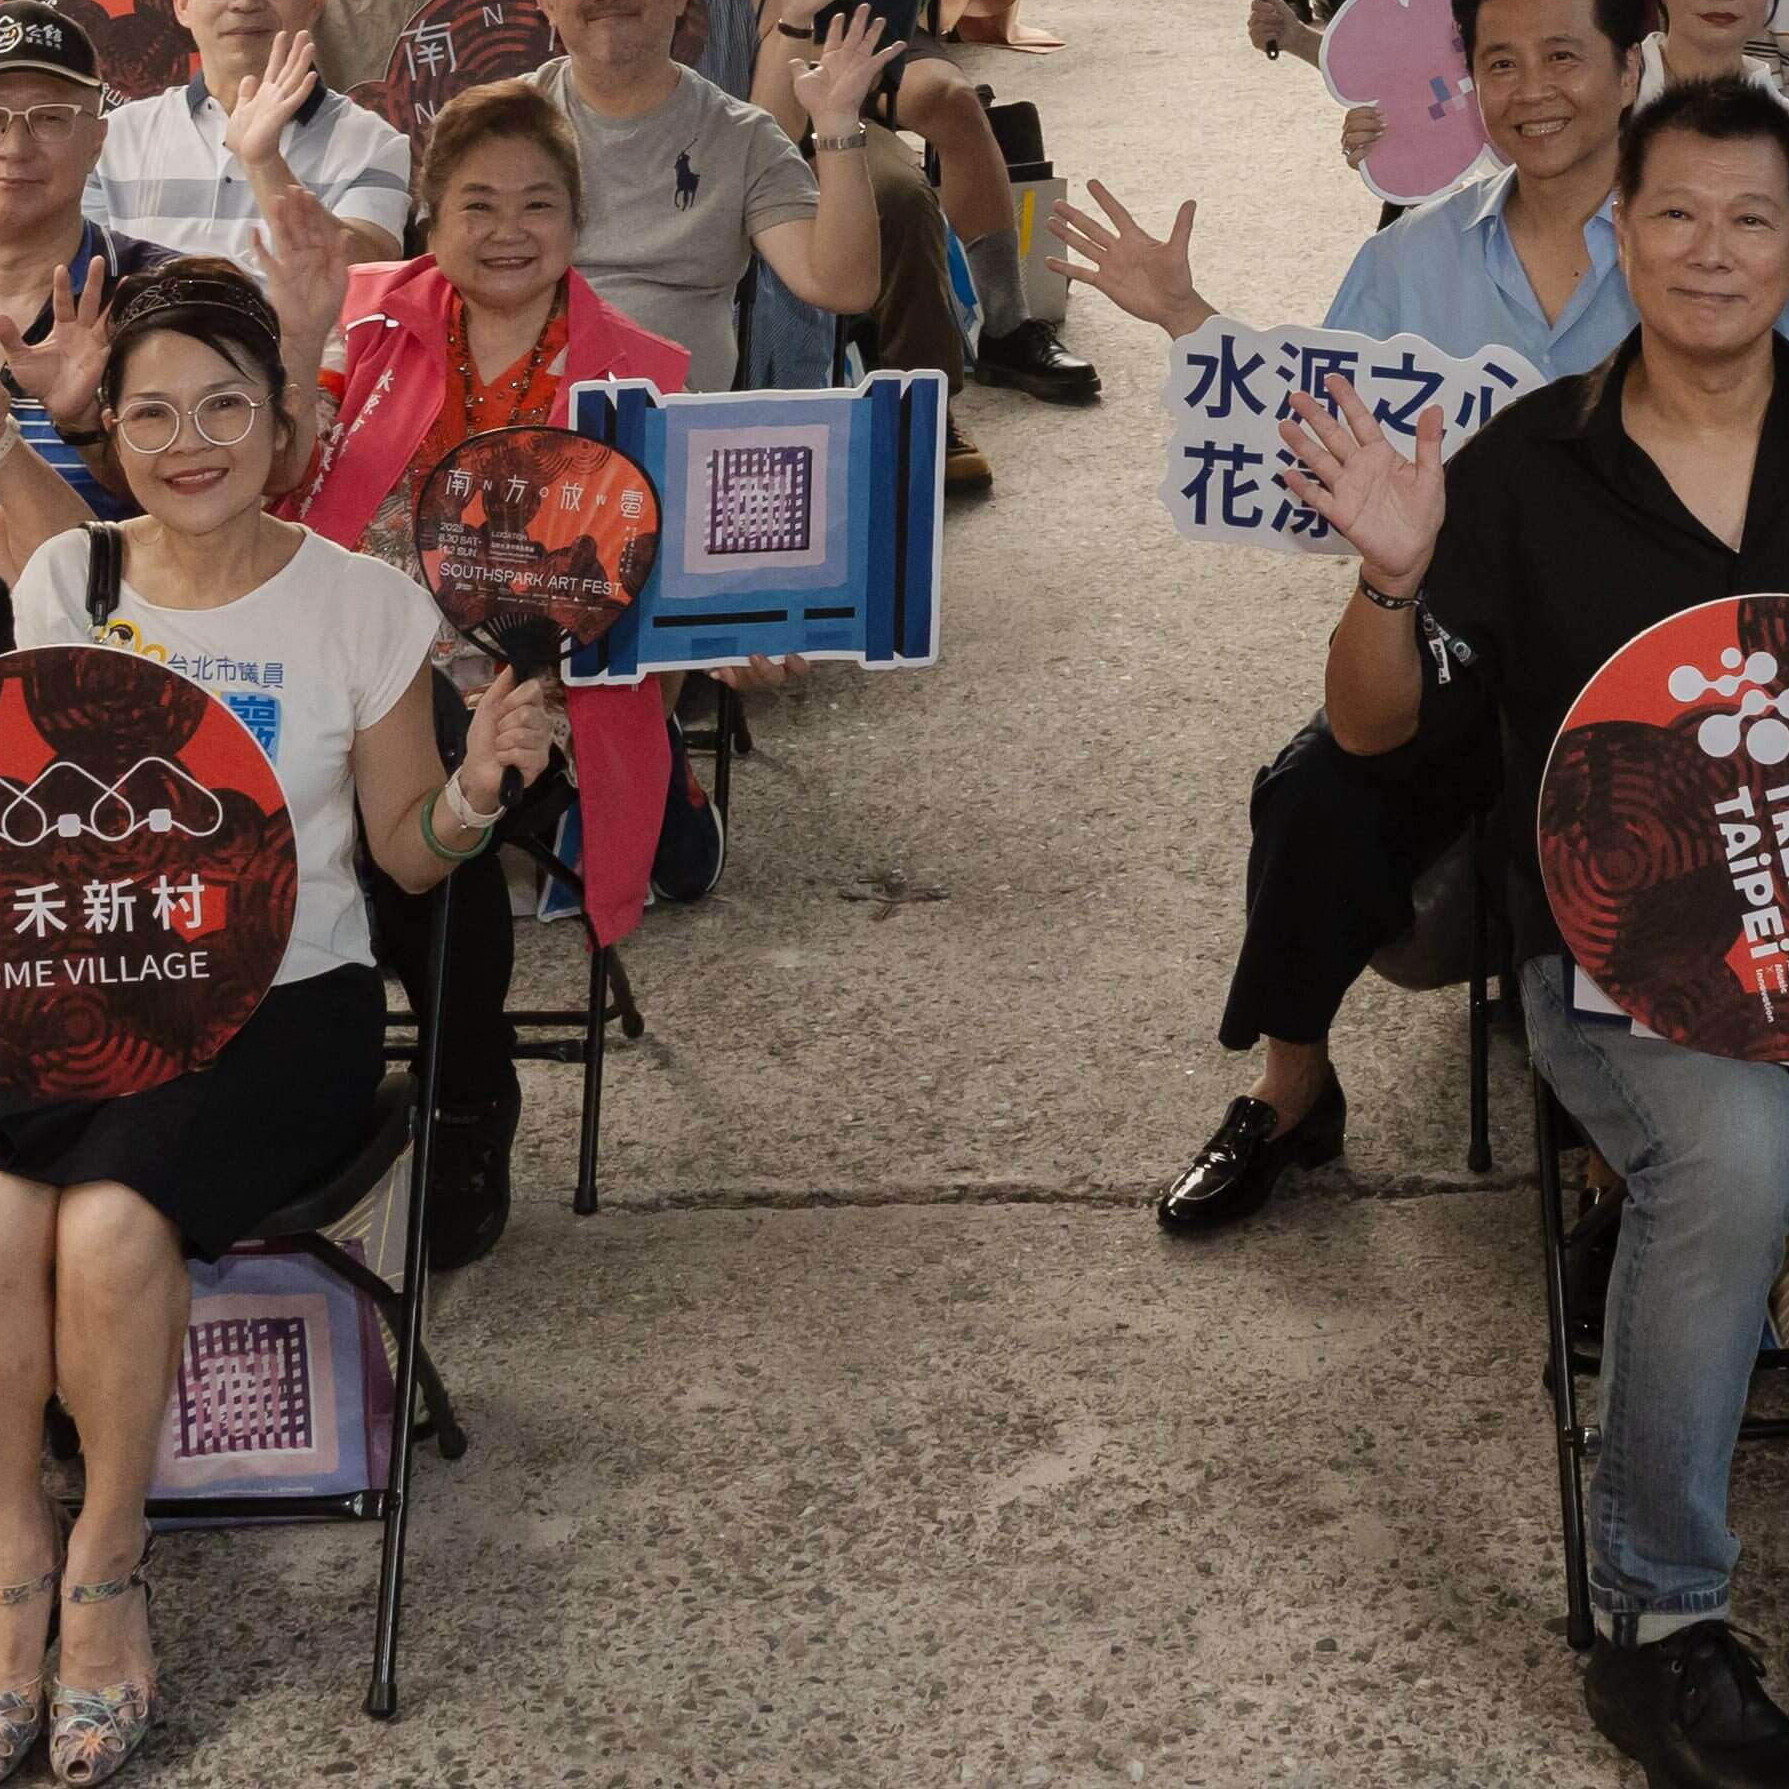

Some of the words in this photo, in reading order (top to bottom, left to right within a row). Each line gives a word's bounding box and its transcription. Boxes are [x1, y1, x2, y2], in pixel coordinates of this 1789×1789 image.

[401, 19, 457, 81] 南
[1183, 337, 1519, 439] 水源之心
[439, 562, 544, 589] SOUTHSPARK
[547, 575, 578, 592] ART
[581, 578, 623, 596] FEST
[168, 652, 284, 690] 台北市議員
[62, 950, 212, 990] VILLAGE
